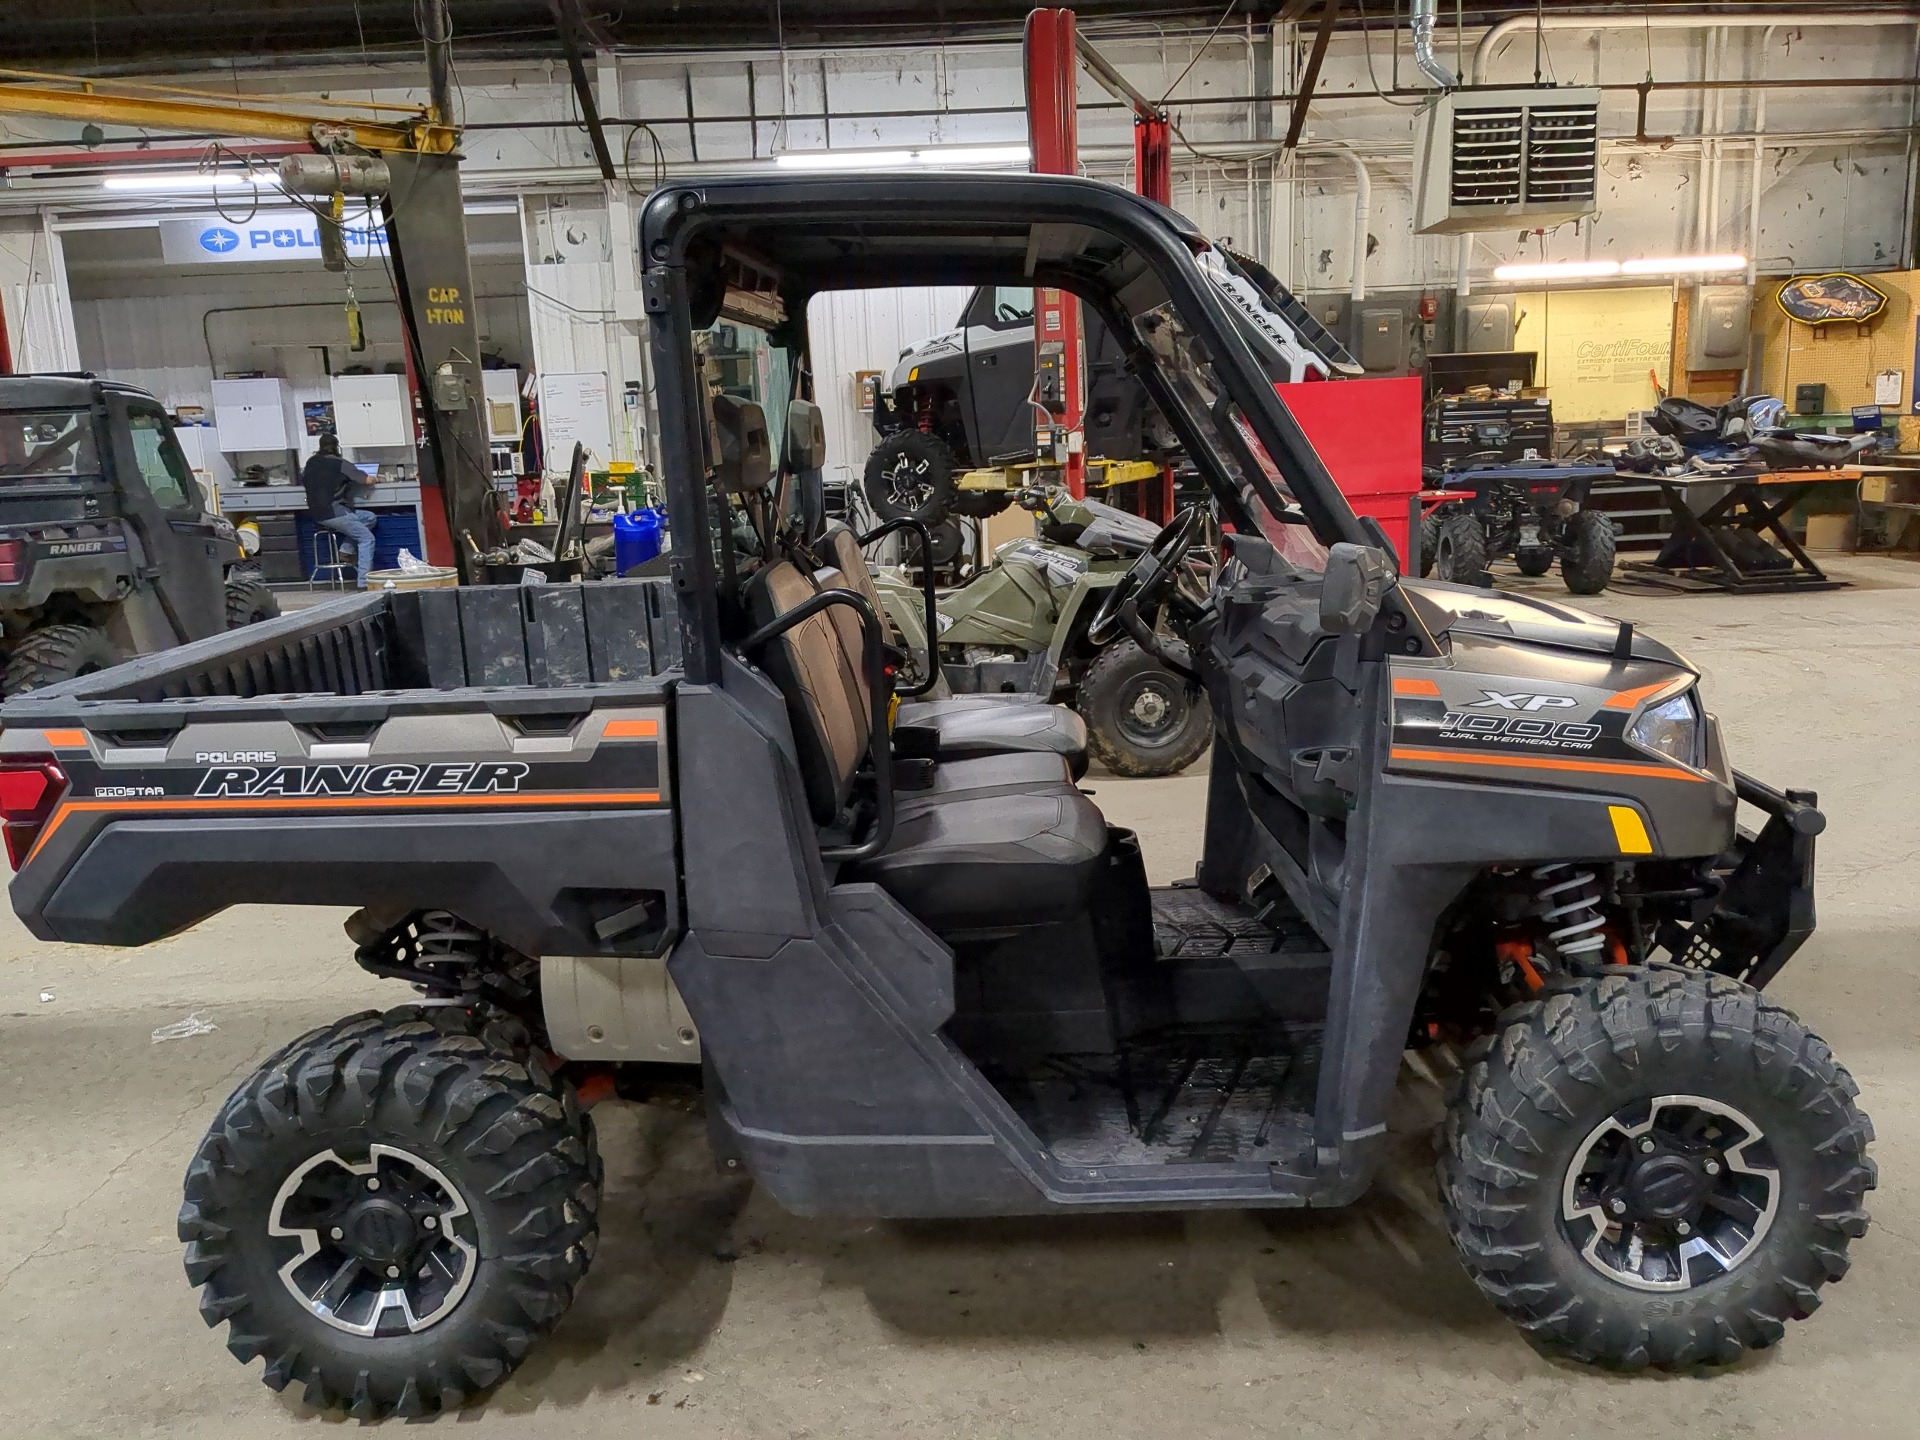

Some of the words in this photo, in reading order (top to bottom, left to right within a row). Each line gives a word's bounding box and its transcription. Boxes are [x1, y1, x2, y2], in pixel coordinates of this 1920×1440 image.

[1220, 281, 1288, 346] RANGER
[50, 541, 102, 555] RANGER
[1458, 690, 1579, 712] XP
[1439, 711, 1602, 742] 1000
[1439, 731, 1479, 741] DUAL
[1482, 735, 1560, 747] OVERHEAD
[1561, 741, 1593, 750] CAM
[195, 751, 277, 764] POLARIS
[194, 761, 530, 797] RANGER
[95, 786, 165, 797] PROSTAR
